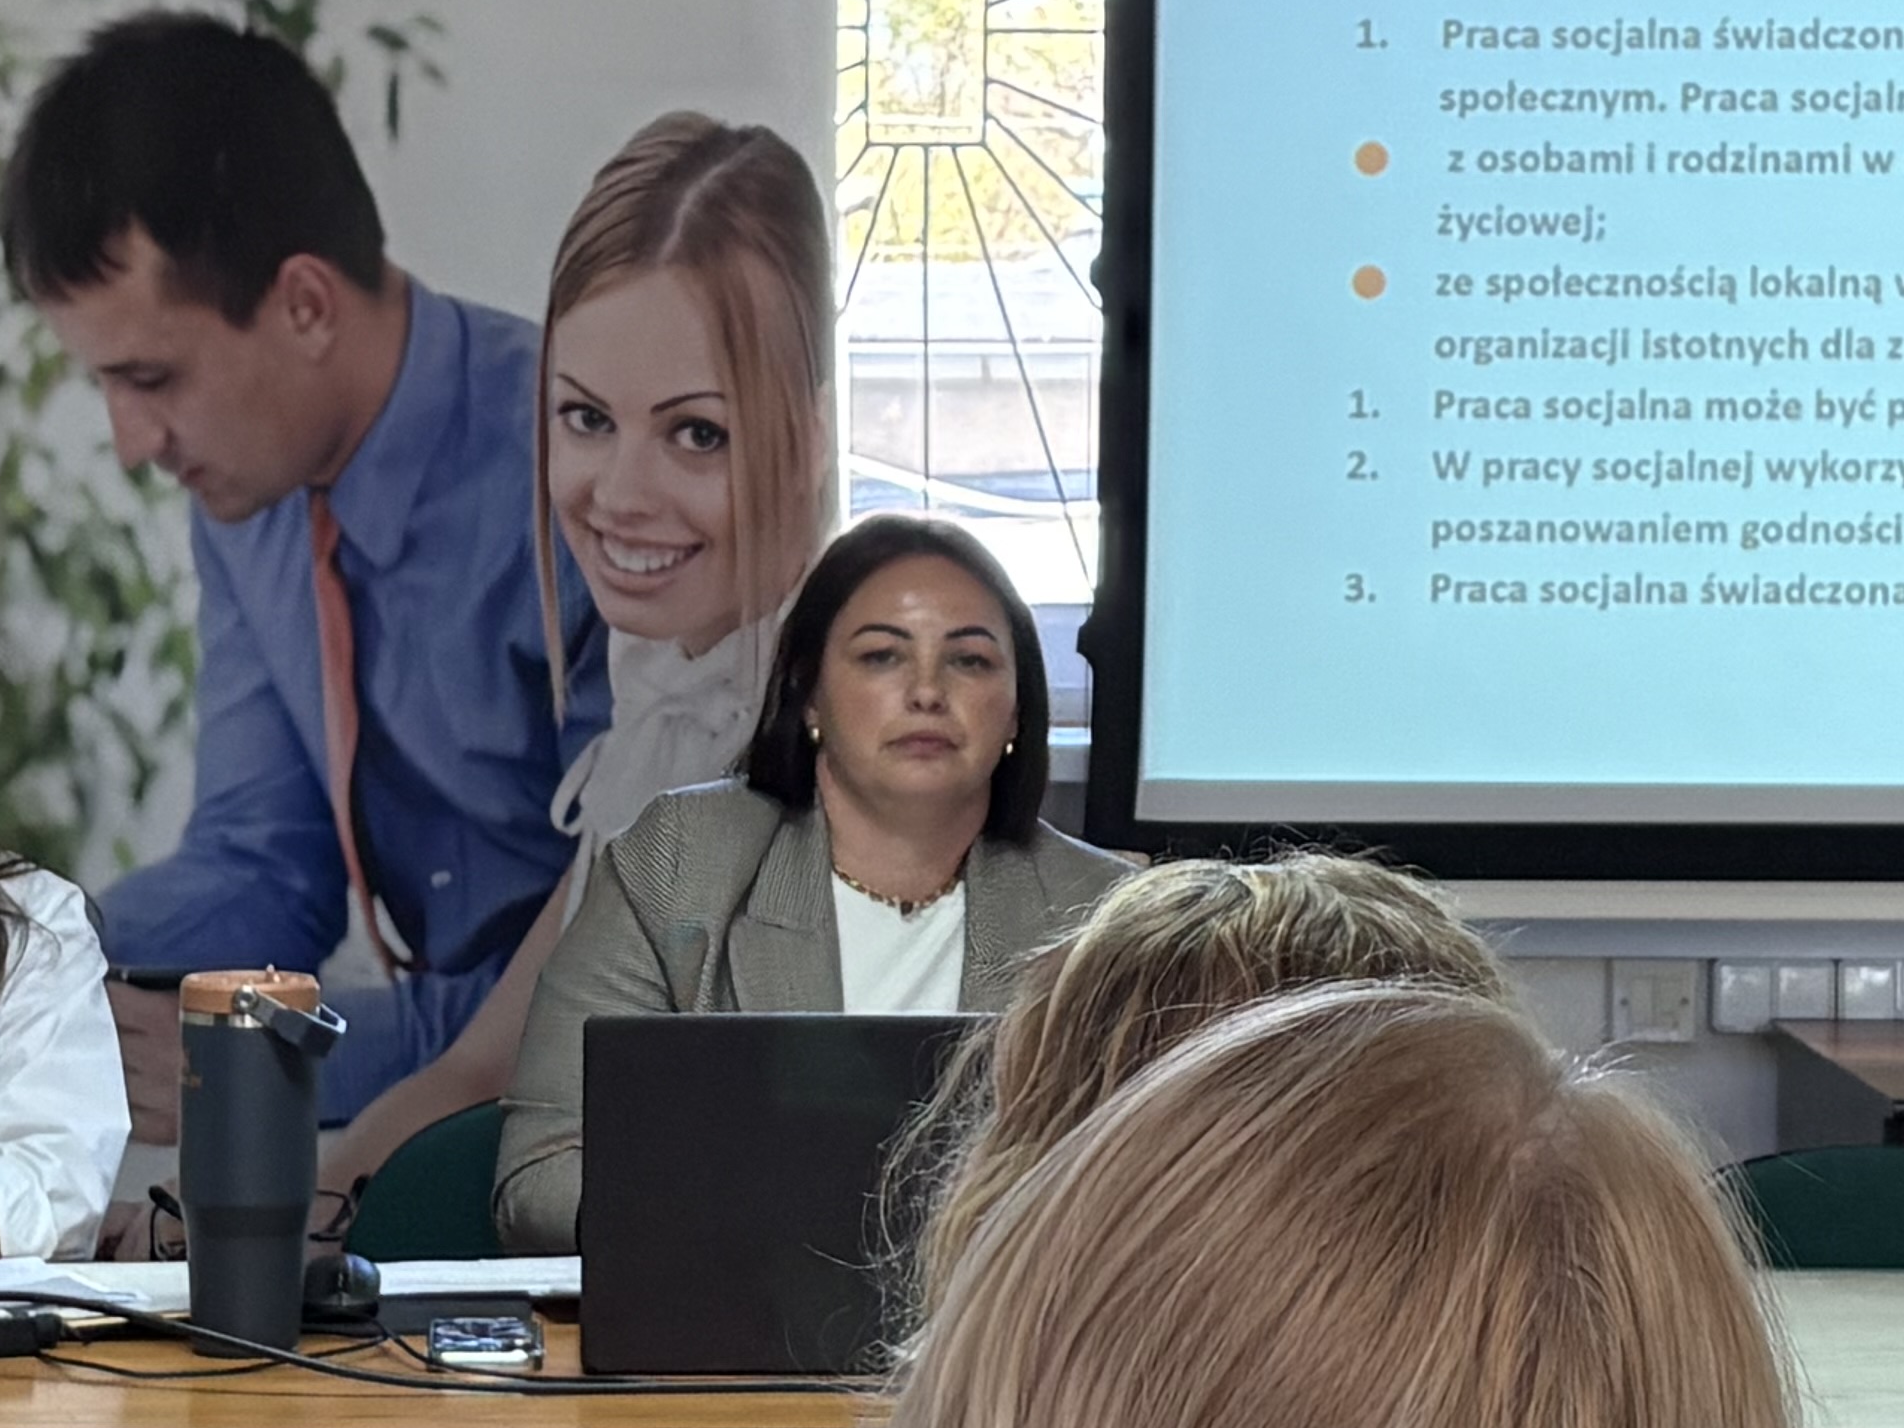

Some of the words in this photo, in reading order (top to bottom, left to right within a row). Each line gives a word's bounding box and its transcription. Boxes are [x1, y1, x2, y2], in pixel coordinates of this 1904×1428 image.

[1356, 18, 1389, 50] 1.
[1442, 18, 1541, 50] Praca
[1552, 17, 1702, 57] socjalna
[1439, 79, 1668, 119] społecznym.
[1680, 81, 1779, 113] Praca
[1447, 149, 1465, 174] z
[1476, 140, 1635, 174] osobami
[1646, 141, 1656, 174] i
[1666, 141, 1852, 175] rodzinami
[1862, 150, 1895, 175] w
[1436, 203, 1606, 244] życiowej;
[1435, 273, 1474, 297] ze
[1485, 264, 1738, 305] społecznością
[1749, 264, 1883, 306] lokalną
[1434, 327, 1630, 367] organizacji
[1642, 327, 1809, 367] istotnych
[1820, 327, 1876, 361] dla
[1349, 389, 1380, 420] 1.
[1433, 389, 1532, 420] Praca
[1543, 387, 1693, 428] socjalna
[1704, 388, 1803, 422] może
[1814, 388, 1877, 429] być
[1346, 450, 1379, 481] 2.
[1432, 450, 1471, 481] W
[1482, 457, 1582, 489] pracy
[1592, 449, 1754, 490] socjalnej
[1431, 511, 1729, 550] poszanowaniem
[1739, 511, 1903, 552] godności
[1344, 573, 1377, 603] 3.
[1430, 572, 1528, 604] Praca
[1539, 572, 1688, 611] socjalna
